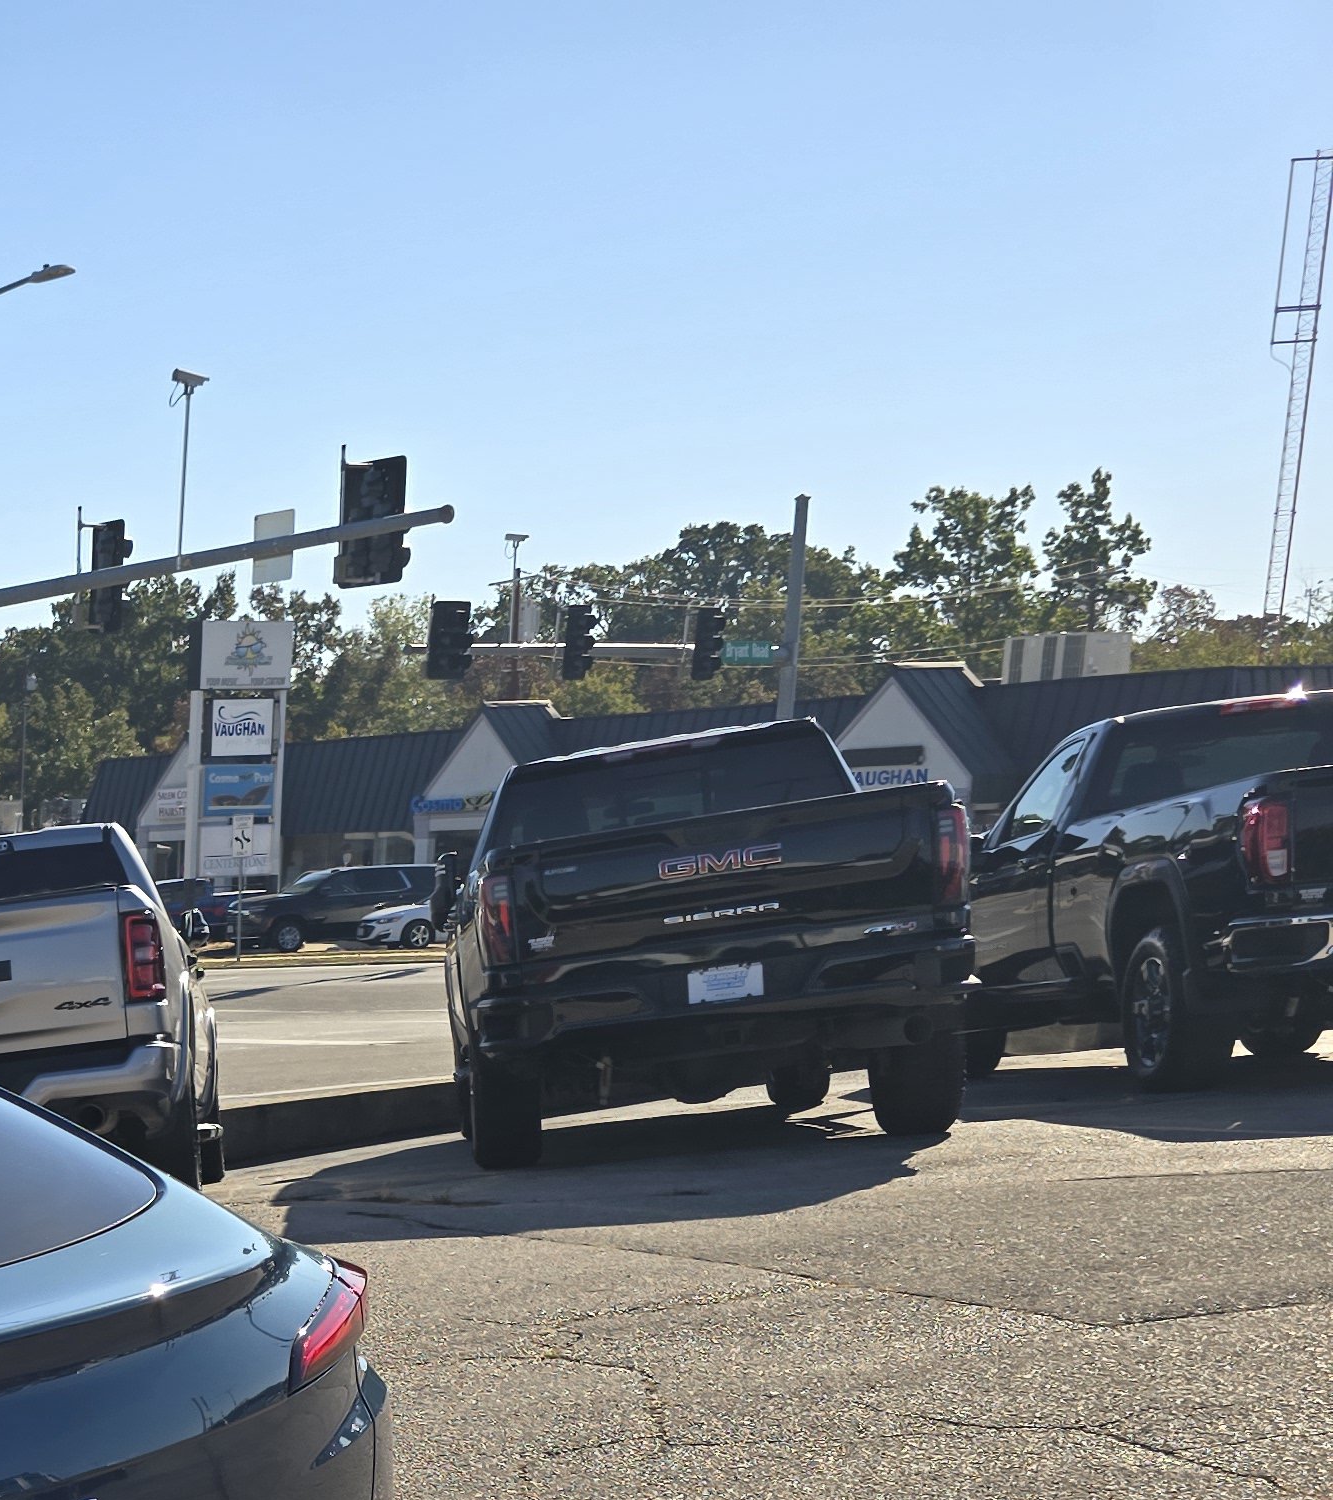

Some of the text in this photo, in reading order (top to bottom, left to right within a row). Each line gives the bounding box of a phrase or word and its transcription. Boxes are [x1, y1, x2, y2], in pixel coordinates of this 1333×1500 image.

[214, 721, 265, 736] VAUGHAN
[658, 843, 782, 880] GMC
[663, 902, 780, 924] SIERRA
